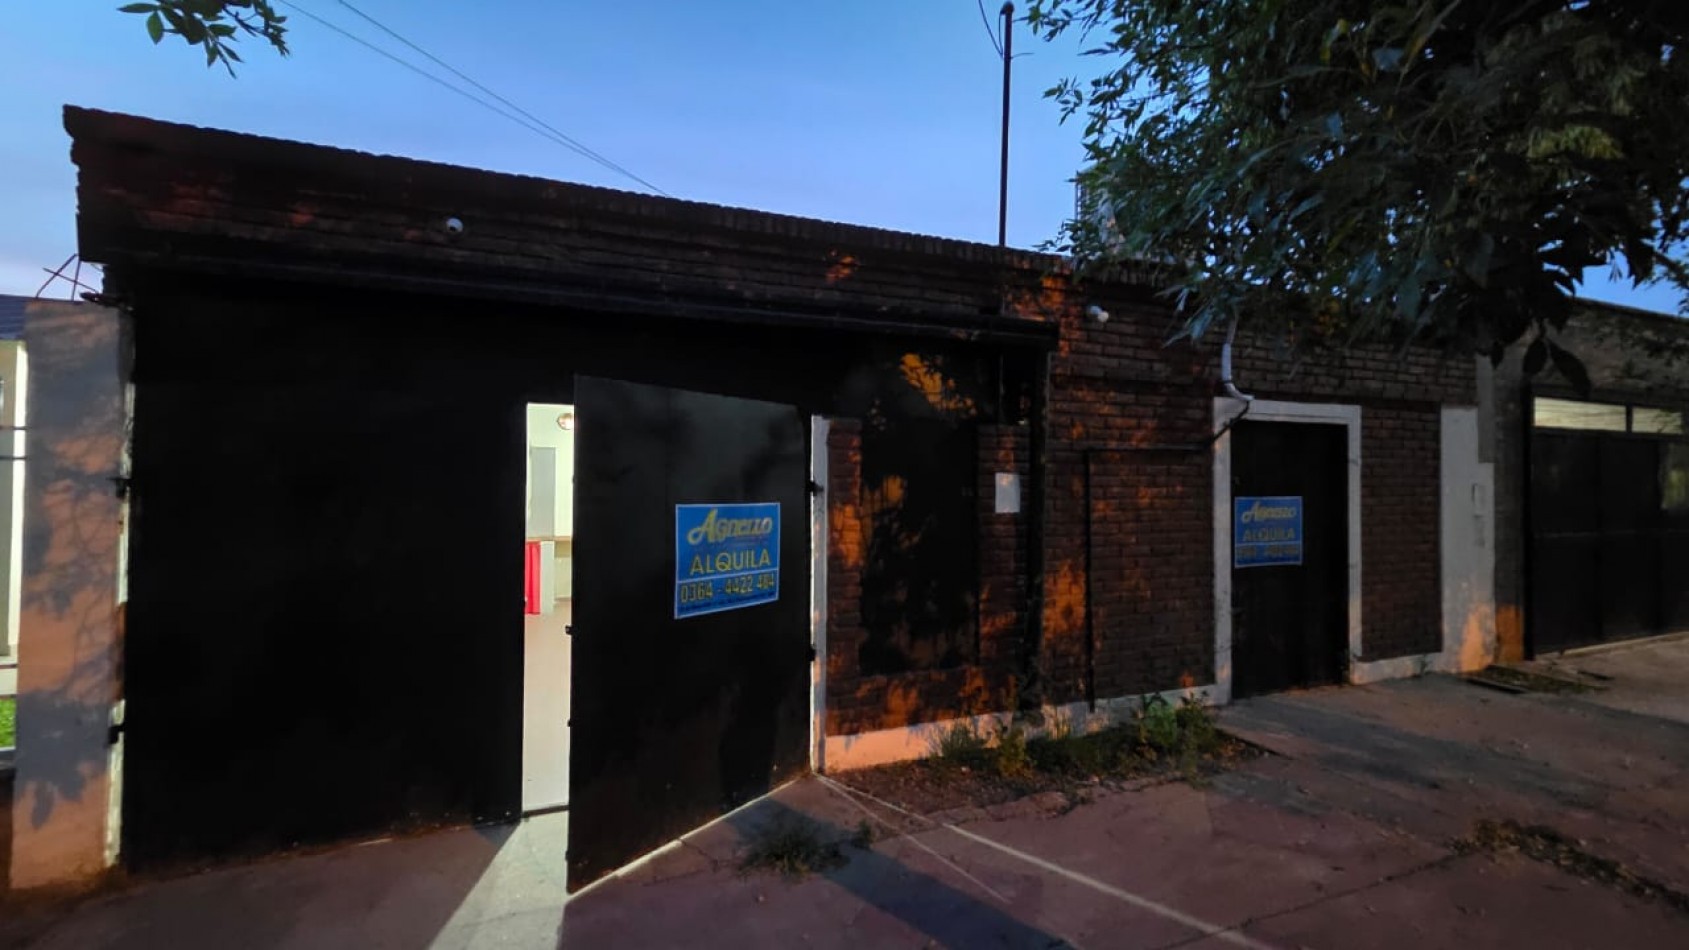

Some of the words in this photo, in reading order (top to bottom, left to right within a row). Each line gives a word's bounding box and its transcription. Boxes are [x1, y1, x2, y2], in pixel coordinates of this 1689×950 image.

[690, 550, 770, 576] ALQUILA
[681, 582, 713, 603] 0364
[725, 575, 753, 594] 4422
